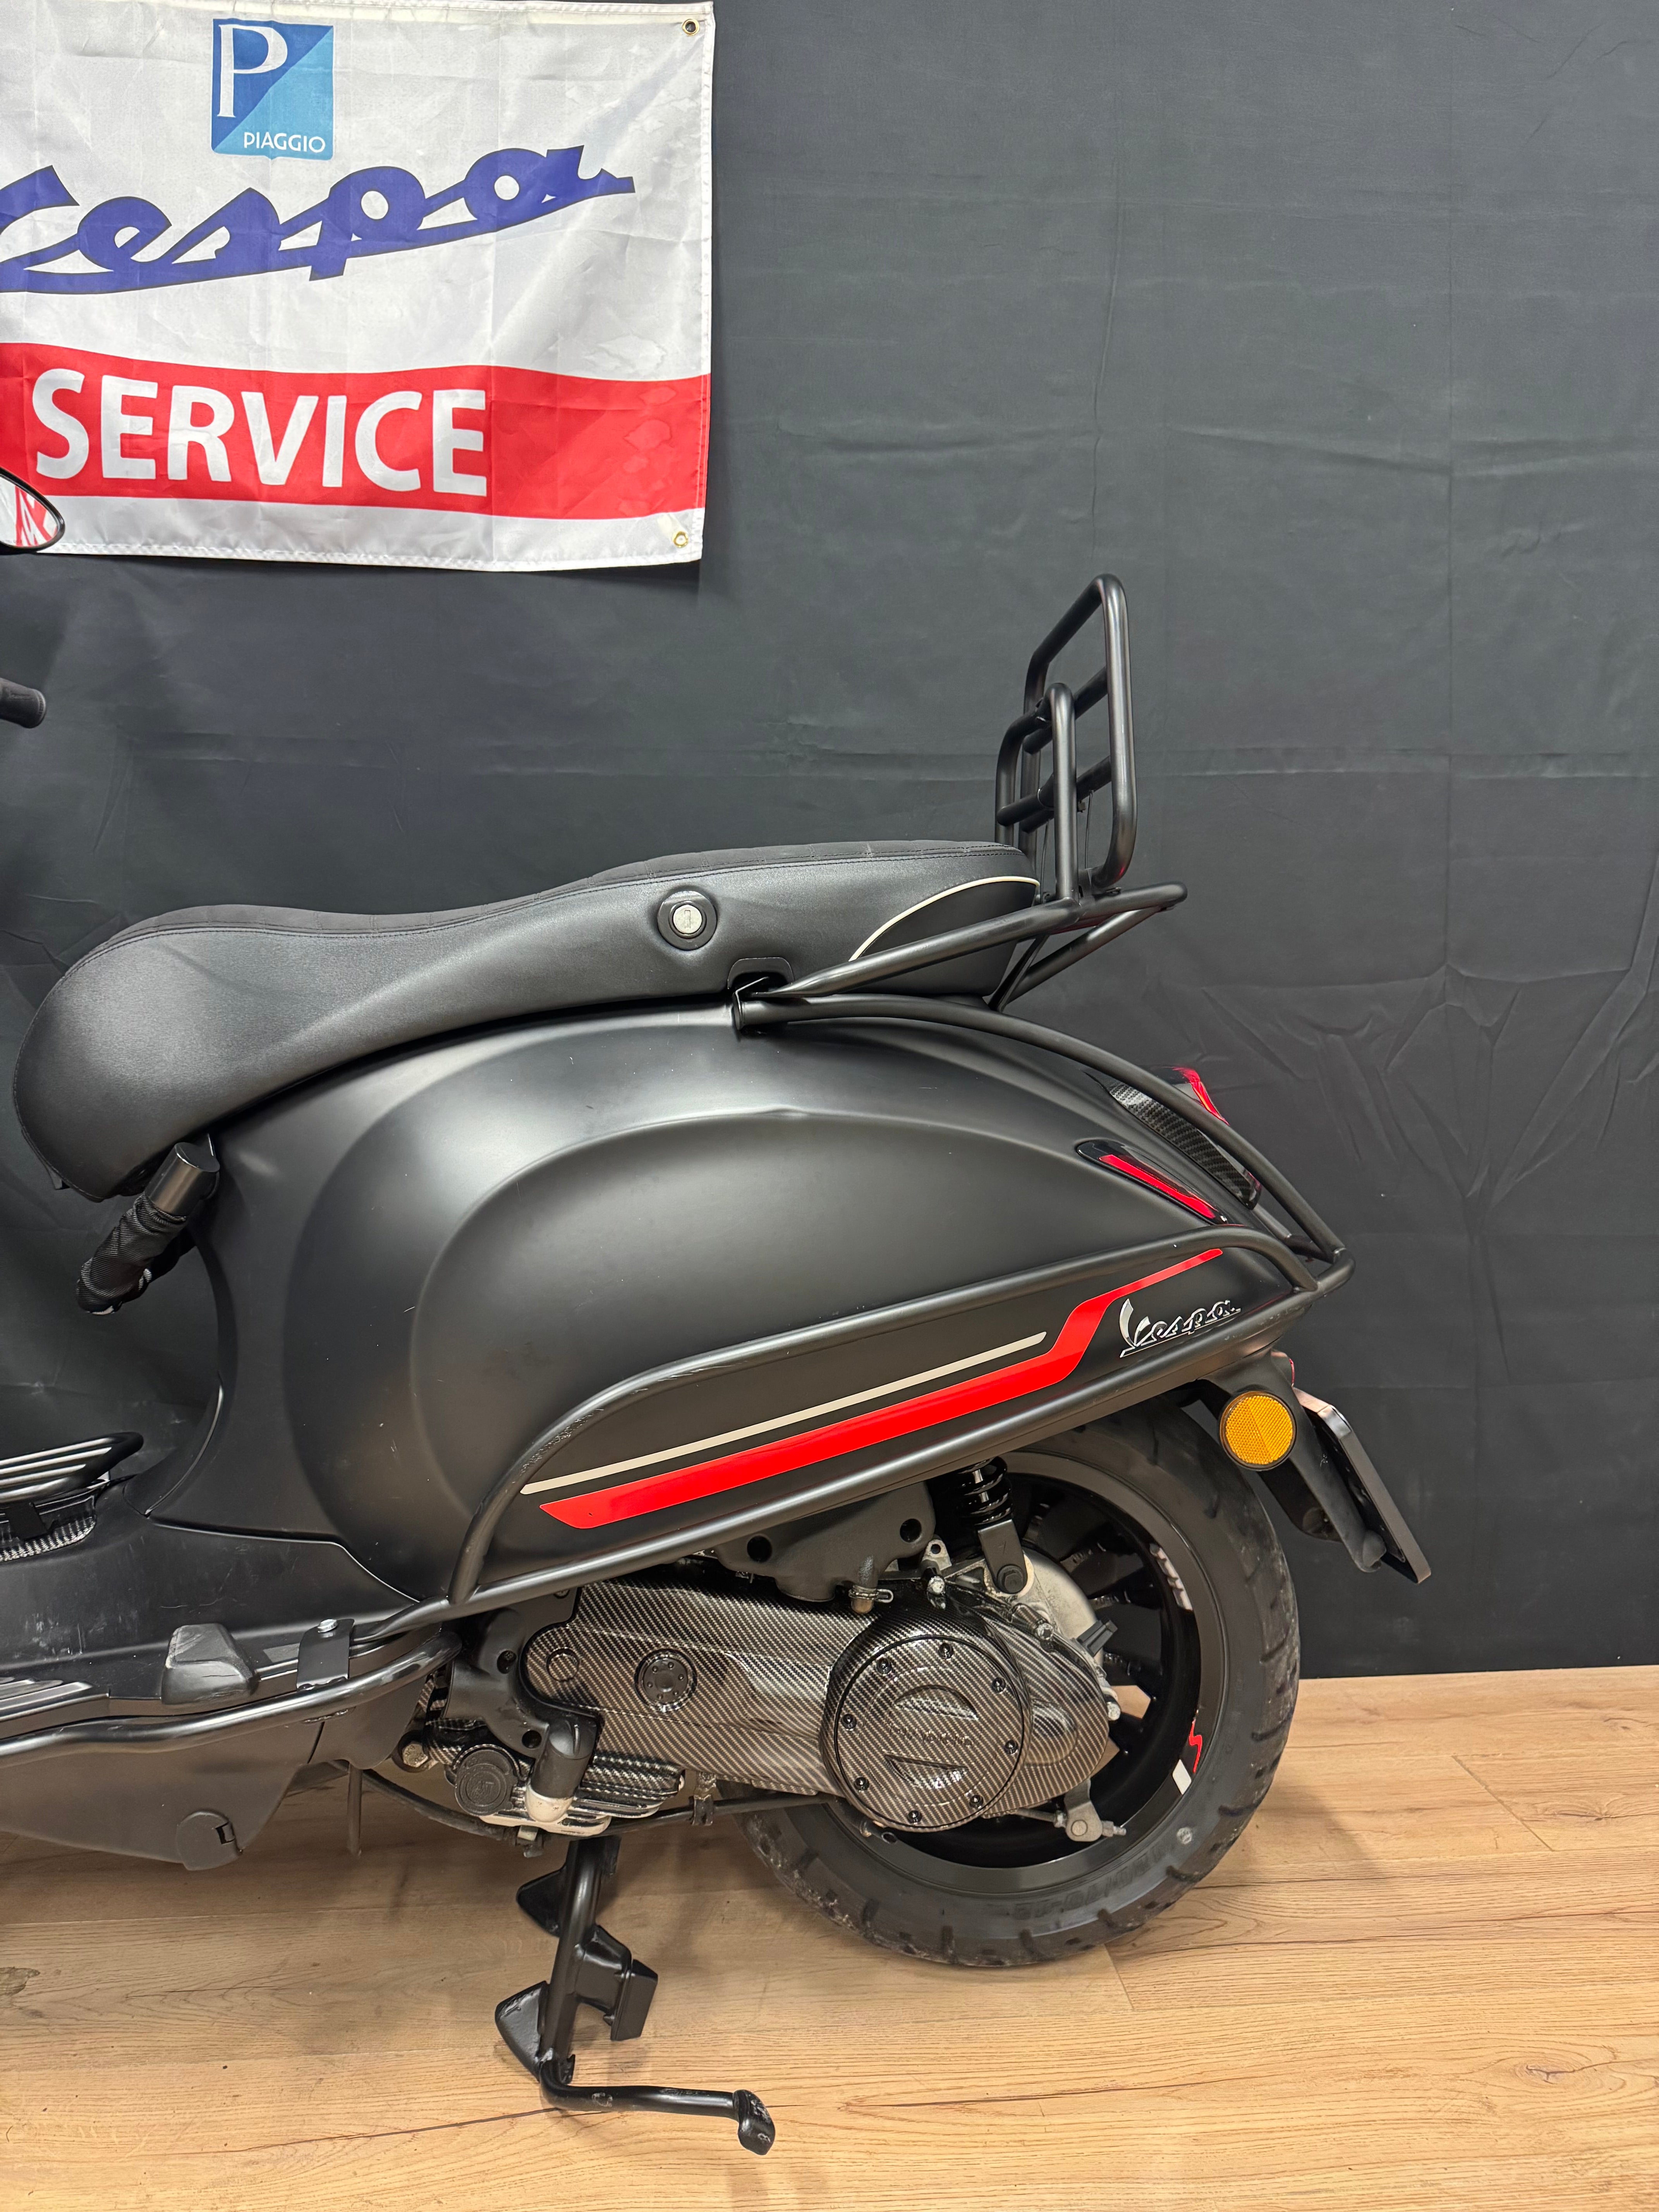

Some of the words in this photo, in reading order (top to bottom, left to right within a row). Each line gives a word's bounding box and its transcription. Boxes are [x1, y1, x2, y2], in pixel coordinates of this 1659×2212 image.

[217, 24, 288, 118] P
[244, 132, 326, 153] PIAGGIO
[32, 369, 487, 497] SERVICE
[1120, 1298, 1241, 1358] Vespa
